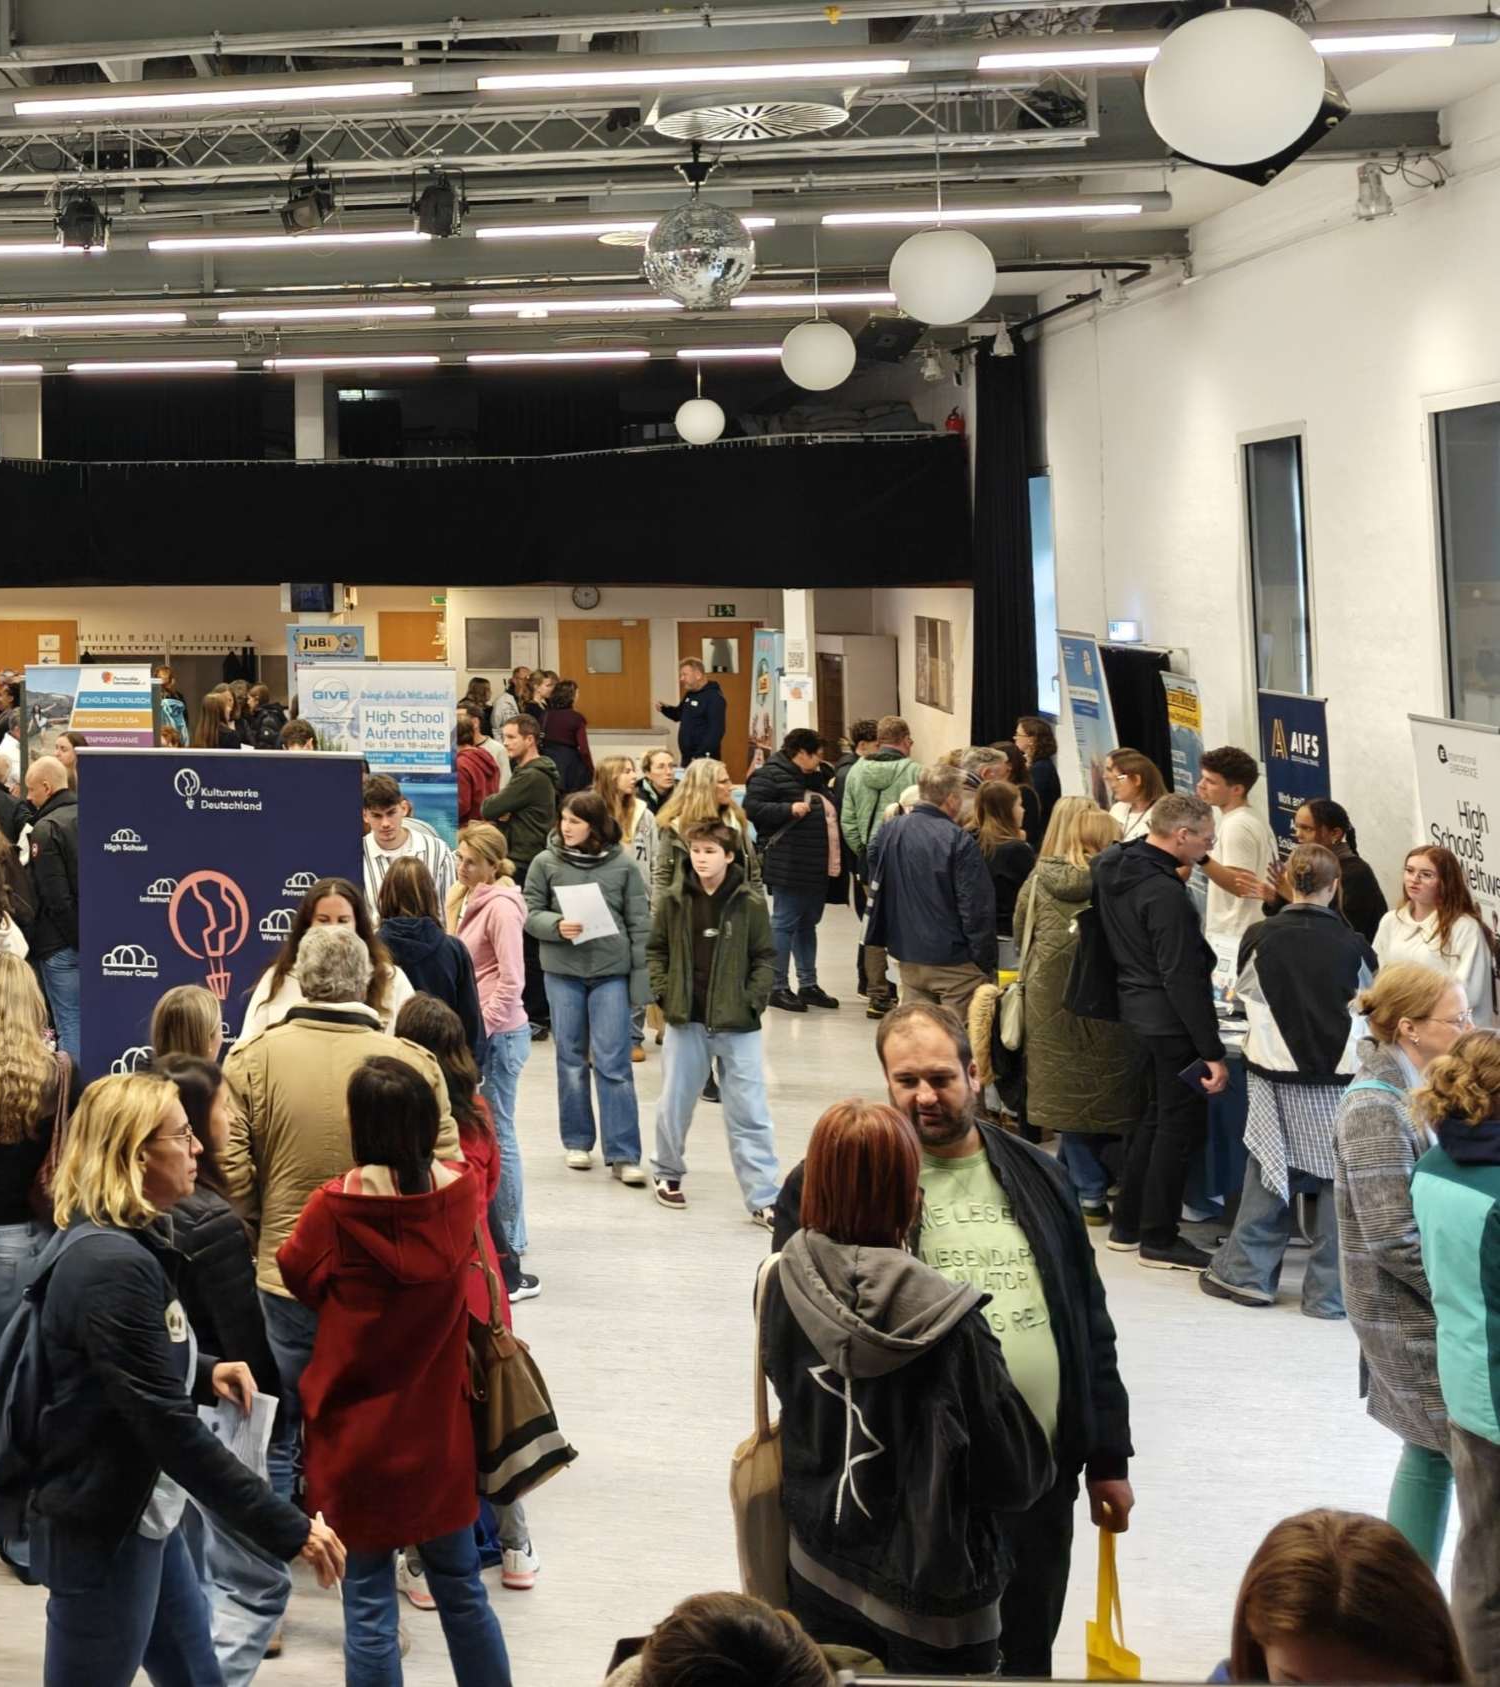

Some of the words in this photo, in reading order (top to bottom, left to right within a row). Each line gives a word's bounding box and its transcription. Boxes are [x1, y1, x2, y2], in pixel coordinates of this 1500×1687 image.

[312, 690, 349, 700] GIVE
[365, 710, 396, 725] High
[400, 710, 444, 723] School
[365, 727, 445, 740] Aufenthalte
[1290, 731, 1320, 758] AIFS
[201, 788, 259, 798] Kulturwerke
[201, 800, 262, 811] Deutschland
[1457, 800, 1489, 839] High
[103, 843, 122, 852] High
[1430, 823, 1484, 863] Schools
[102, 968, 134, 977] Summer
[135, 969, 159, 978] Camp
[922, 1247, 1031, 1269] LEGENDAR
